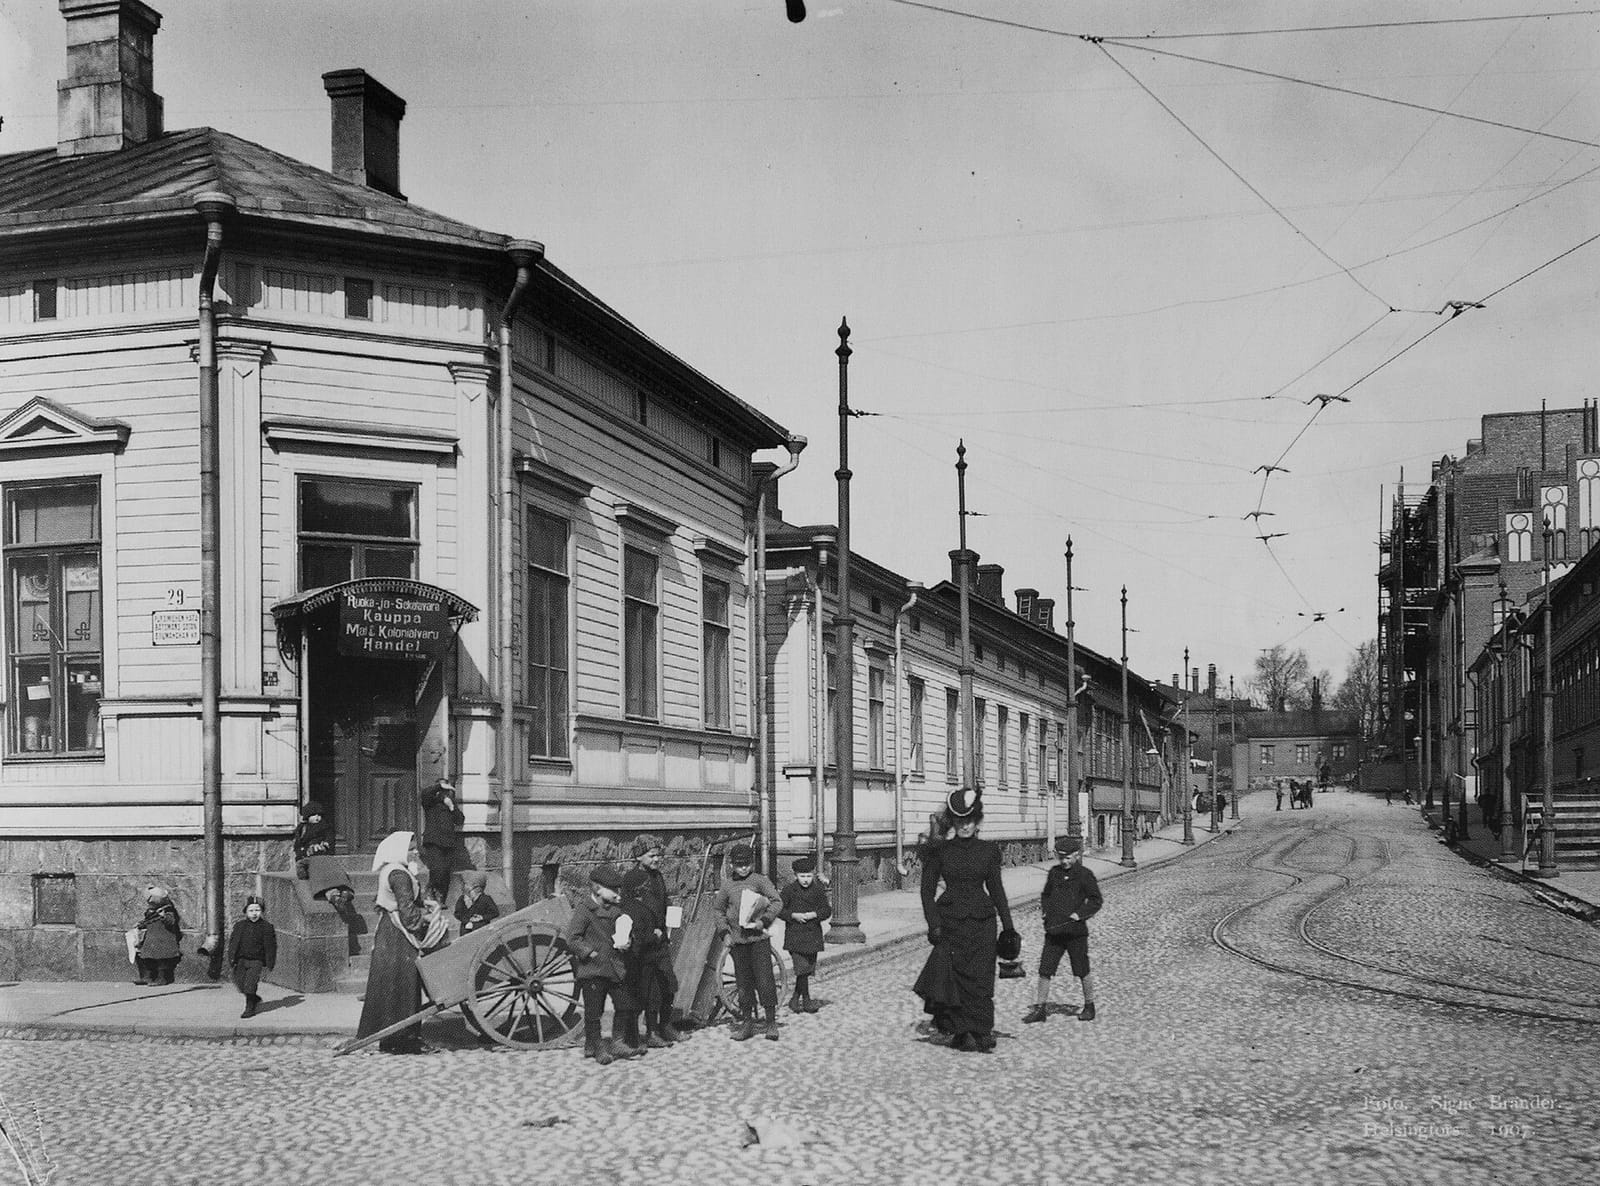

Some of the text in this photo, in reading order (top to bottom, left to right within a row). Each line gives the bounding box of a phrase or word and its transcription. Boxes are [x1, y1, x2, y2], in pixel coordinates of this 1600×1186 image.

[167, 589, 184, 605] 29
[363, 608, 421, 624] Kauppa
[363, 637, 420, 652] Handel
